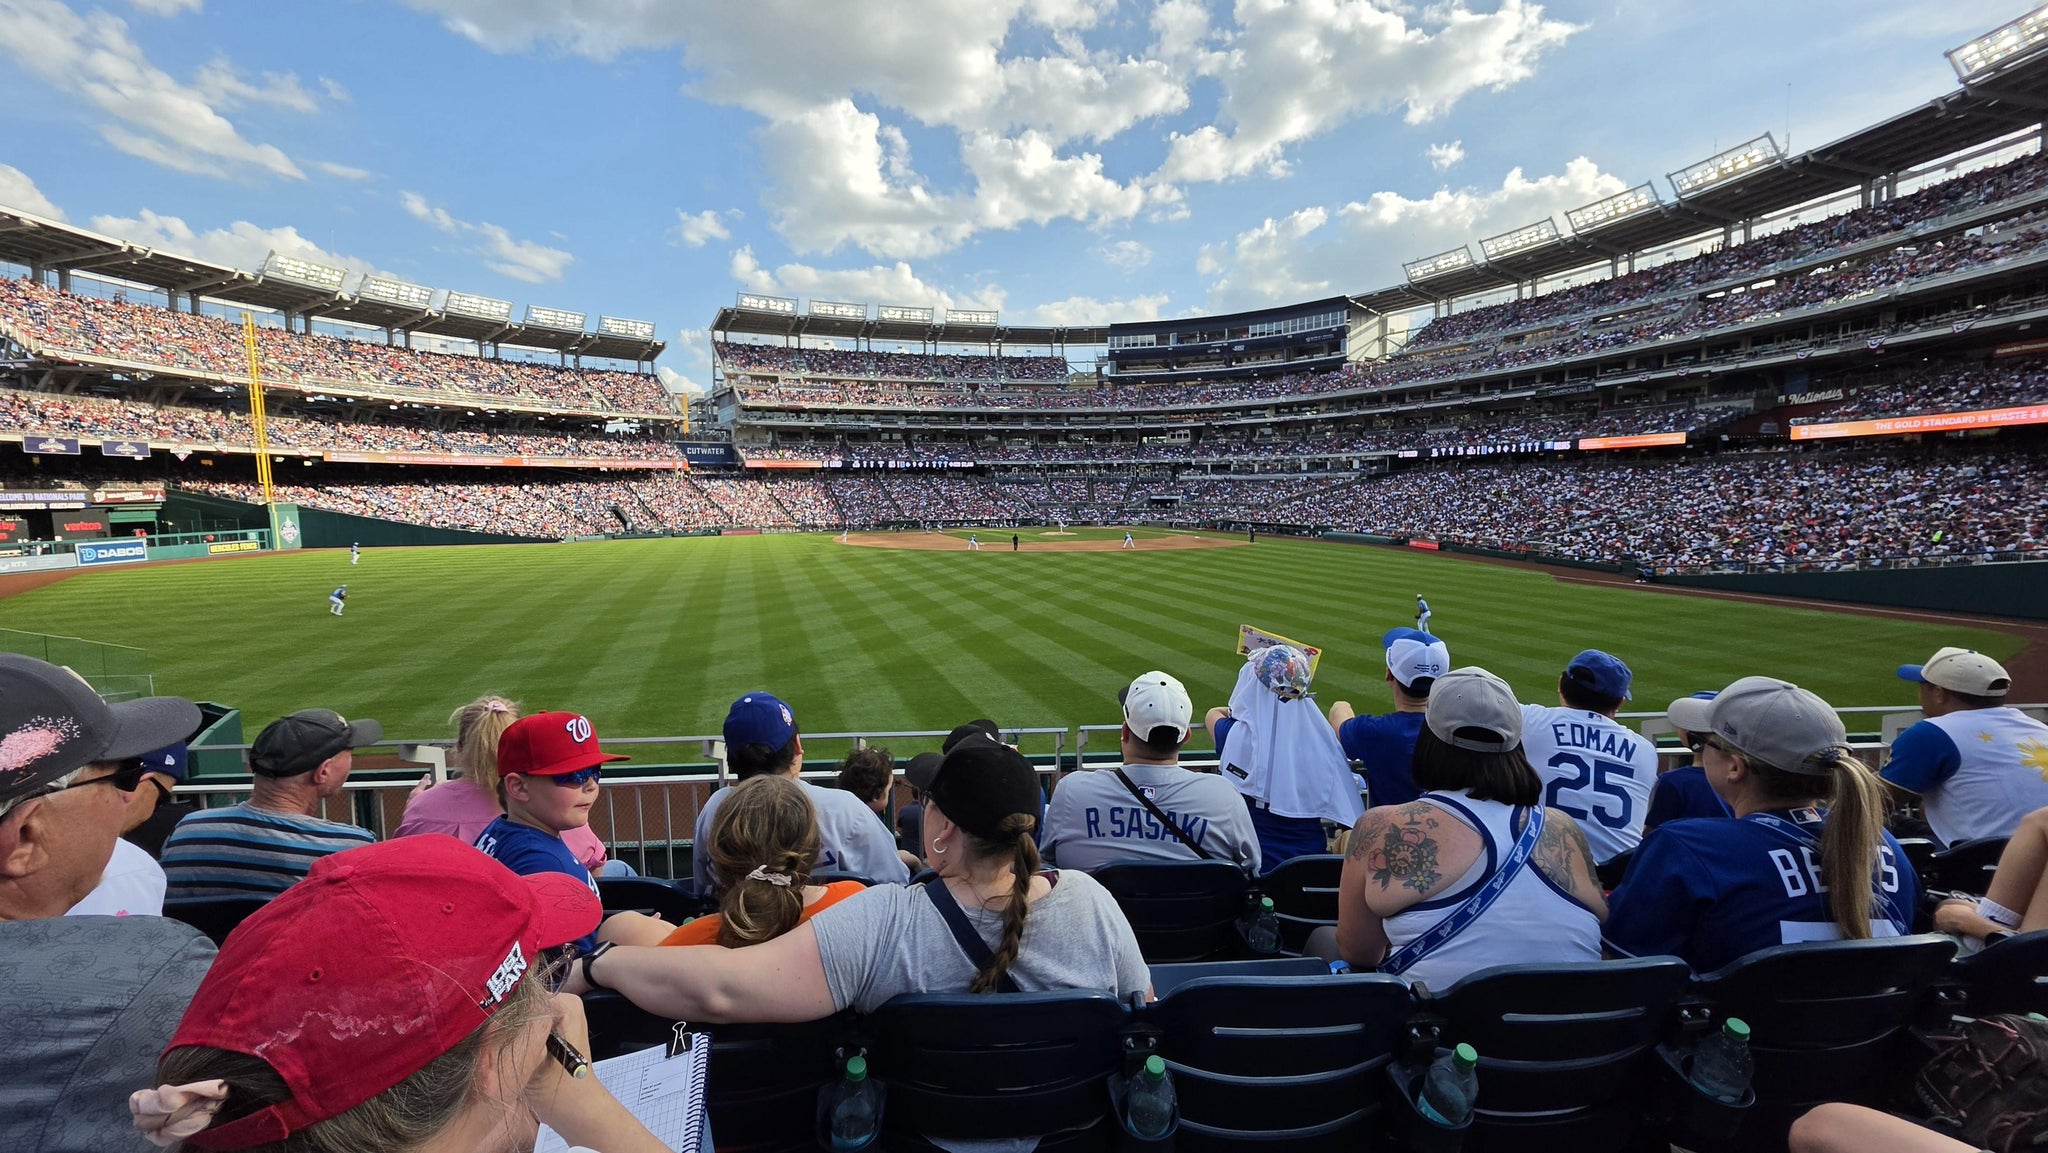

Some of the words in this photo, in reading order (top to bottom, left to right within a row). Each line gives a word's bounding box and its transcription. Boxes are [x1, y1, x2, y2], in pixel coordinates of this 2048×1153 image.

[1788, 388, 1844, 404] Nationals
[1875, 422, 1892, 430] THE
[1895, 420, 1920, 429] GOLD
[1922, 415, 1976, 427] STANDARD
[1978, 414, 1988, 422] IN
[1991, 411, 2028, 421] WASTE
[686, 447, 725, 455] CUTWATER
[25, 493, 33, 501] TO
[34, 493, 68, 501] NATIONALS
[69, 493, 86, 501] PARK
[64, 521, 102, 531] verizon
[97, 547, 144, 558] DABOS
[566, 716, 592, 744] W
[1552, 723, 1637, 762] EDMAN
[1545, 752, 1634, 830] 25
[1768, 846, 1900, 898] BES
